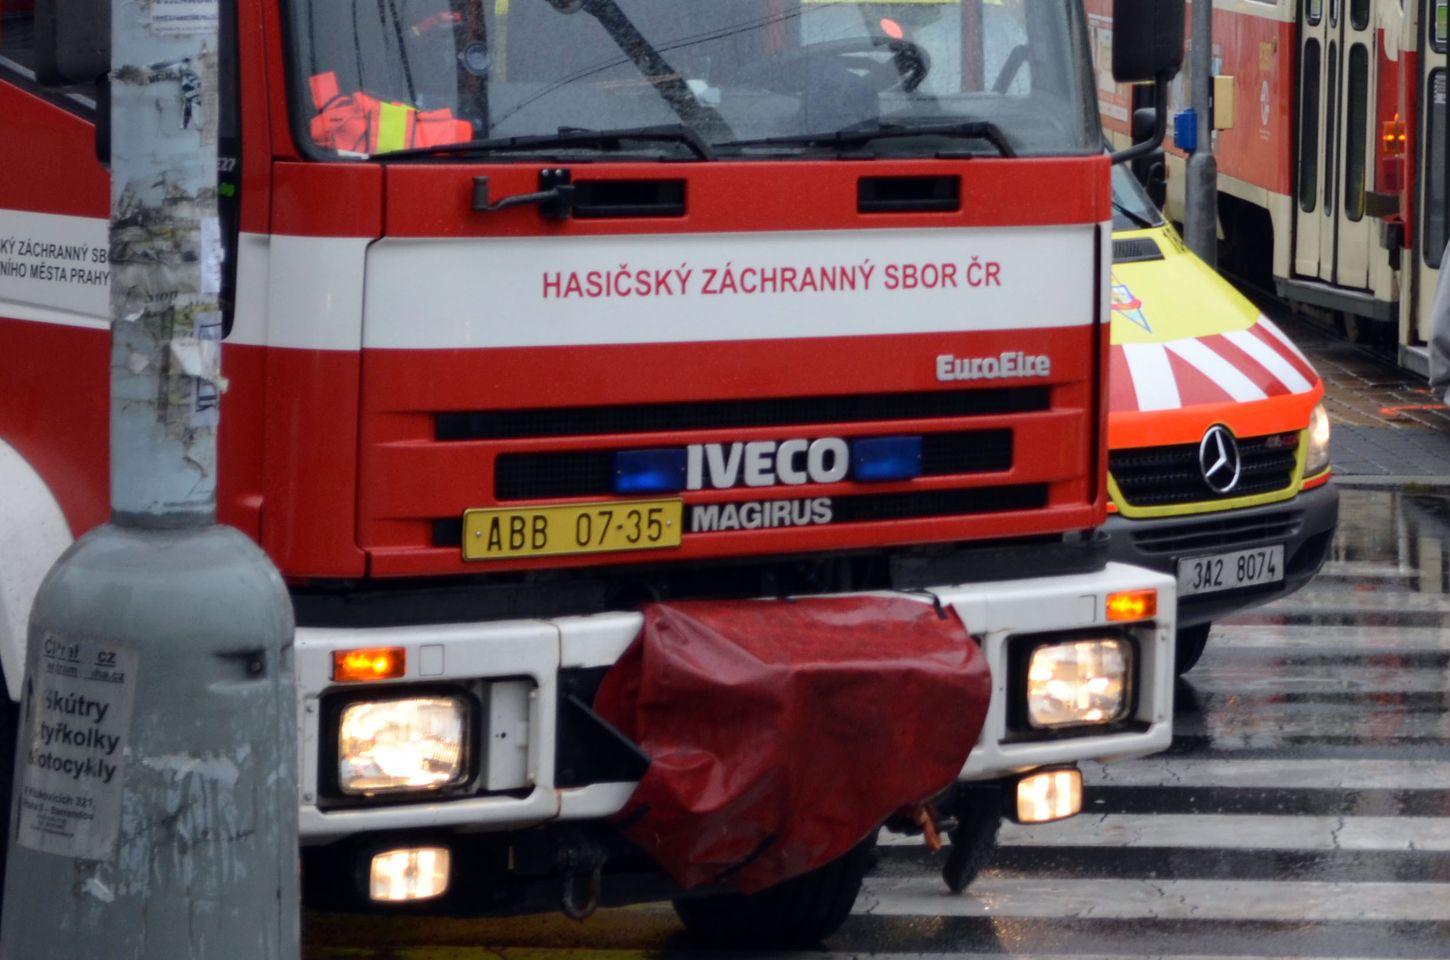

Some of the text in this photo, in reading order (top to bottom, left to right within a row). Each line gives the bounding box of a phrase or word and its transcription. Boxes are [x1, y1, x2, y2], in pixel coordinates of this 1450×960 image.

[0, 236, 107, 264] KÝ ZÁCHRANNÝ SB
[0, 258, 111, 286] NÍHO MĚSTA PRAHY
[542, 256, 1002, 299] HASIČSKÝ ZÁCHRANNÝ SBOR ČR
[687, 437, 850, 490] IVECO
[487, 508, 664, 552] ABB 07-35
[691, 497, 832, 533] MAGIRUS
[1193, 549, 1276, 590] 3A2 8074
[41, 720, 120, 755] tyřkolky
[35, 749, 117, 783] otocykly
